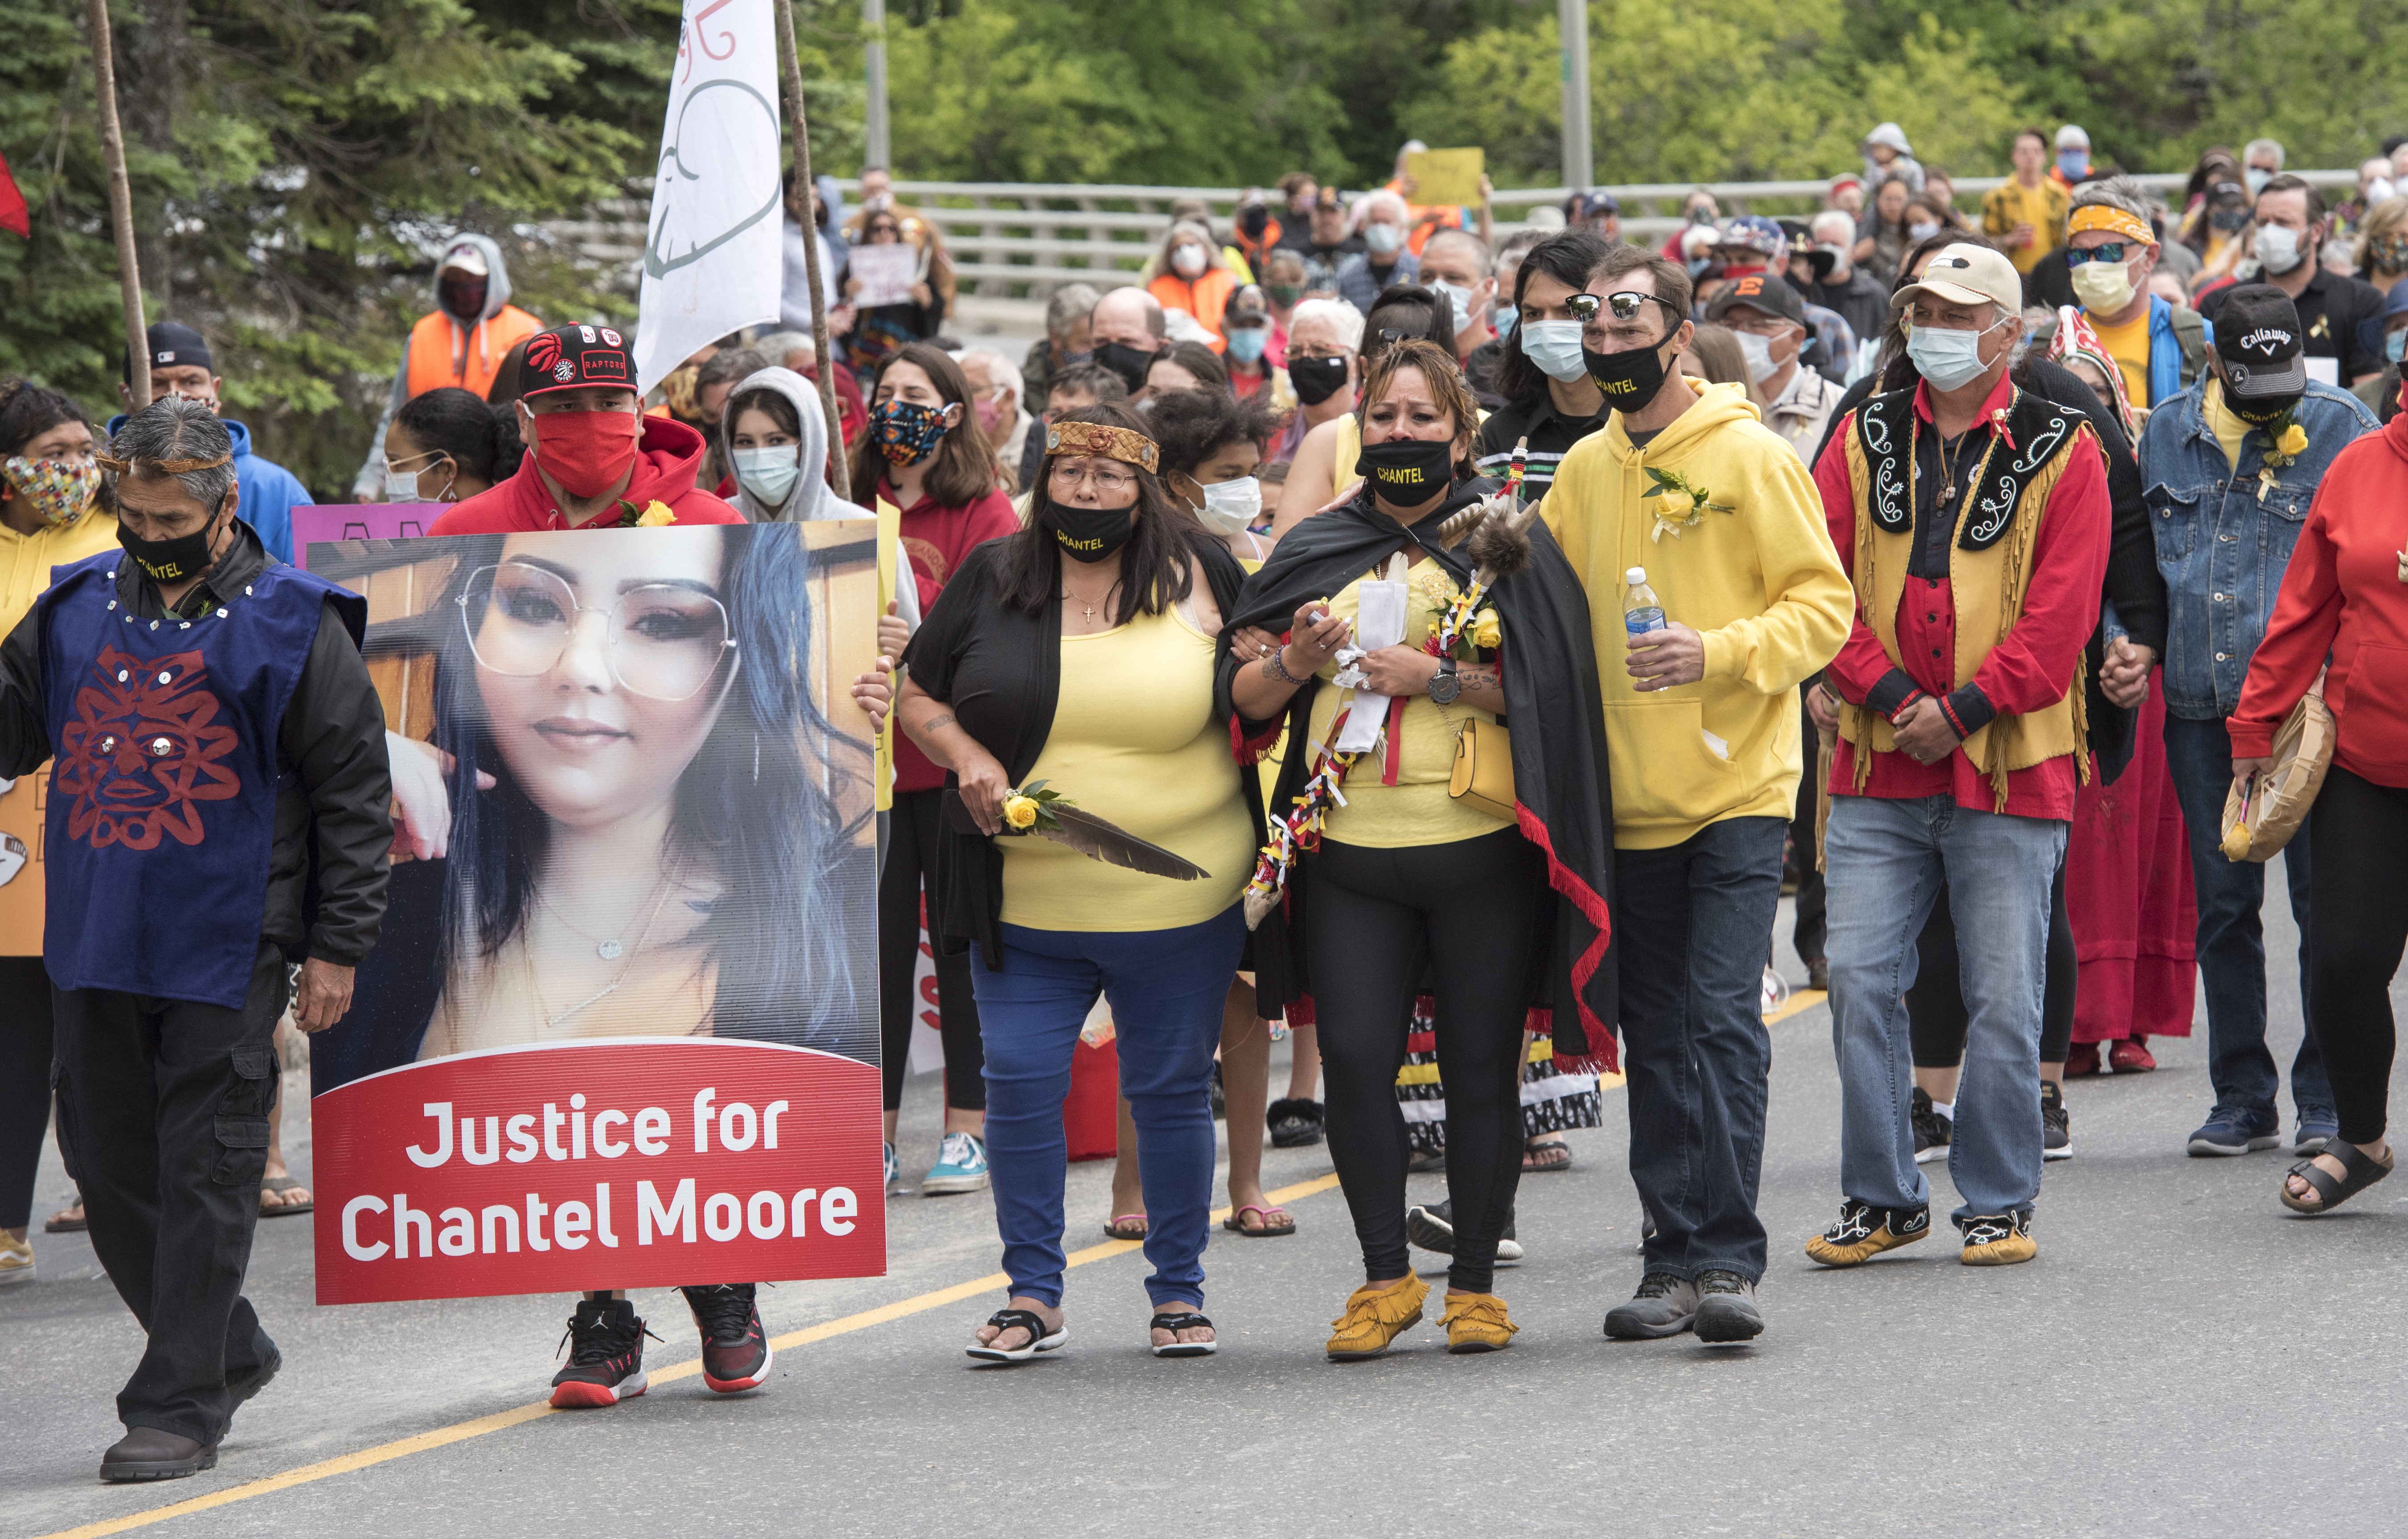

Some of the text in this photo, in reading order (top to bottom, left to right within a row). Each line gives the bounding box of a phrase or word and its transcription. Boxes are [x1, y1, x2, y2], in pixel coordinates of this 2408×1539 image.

[1734, 277, 1764, 296] E
[2240, 328, 2291, 349] Callaway
[554, 360, 573, 370] TORONTO
[585, 361, 624, 369] RAPTORS
[555, 372, 573, 382] RAPTORS
[1377, 467, 1425, 484] CHANTEL
[1057, 529, 1104, 550] CHANTEL
[406, 1087, 788, 1168] Justice for
[342, 1178, 857, 1261] Chantel Moore
